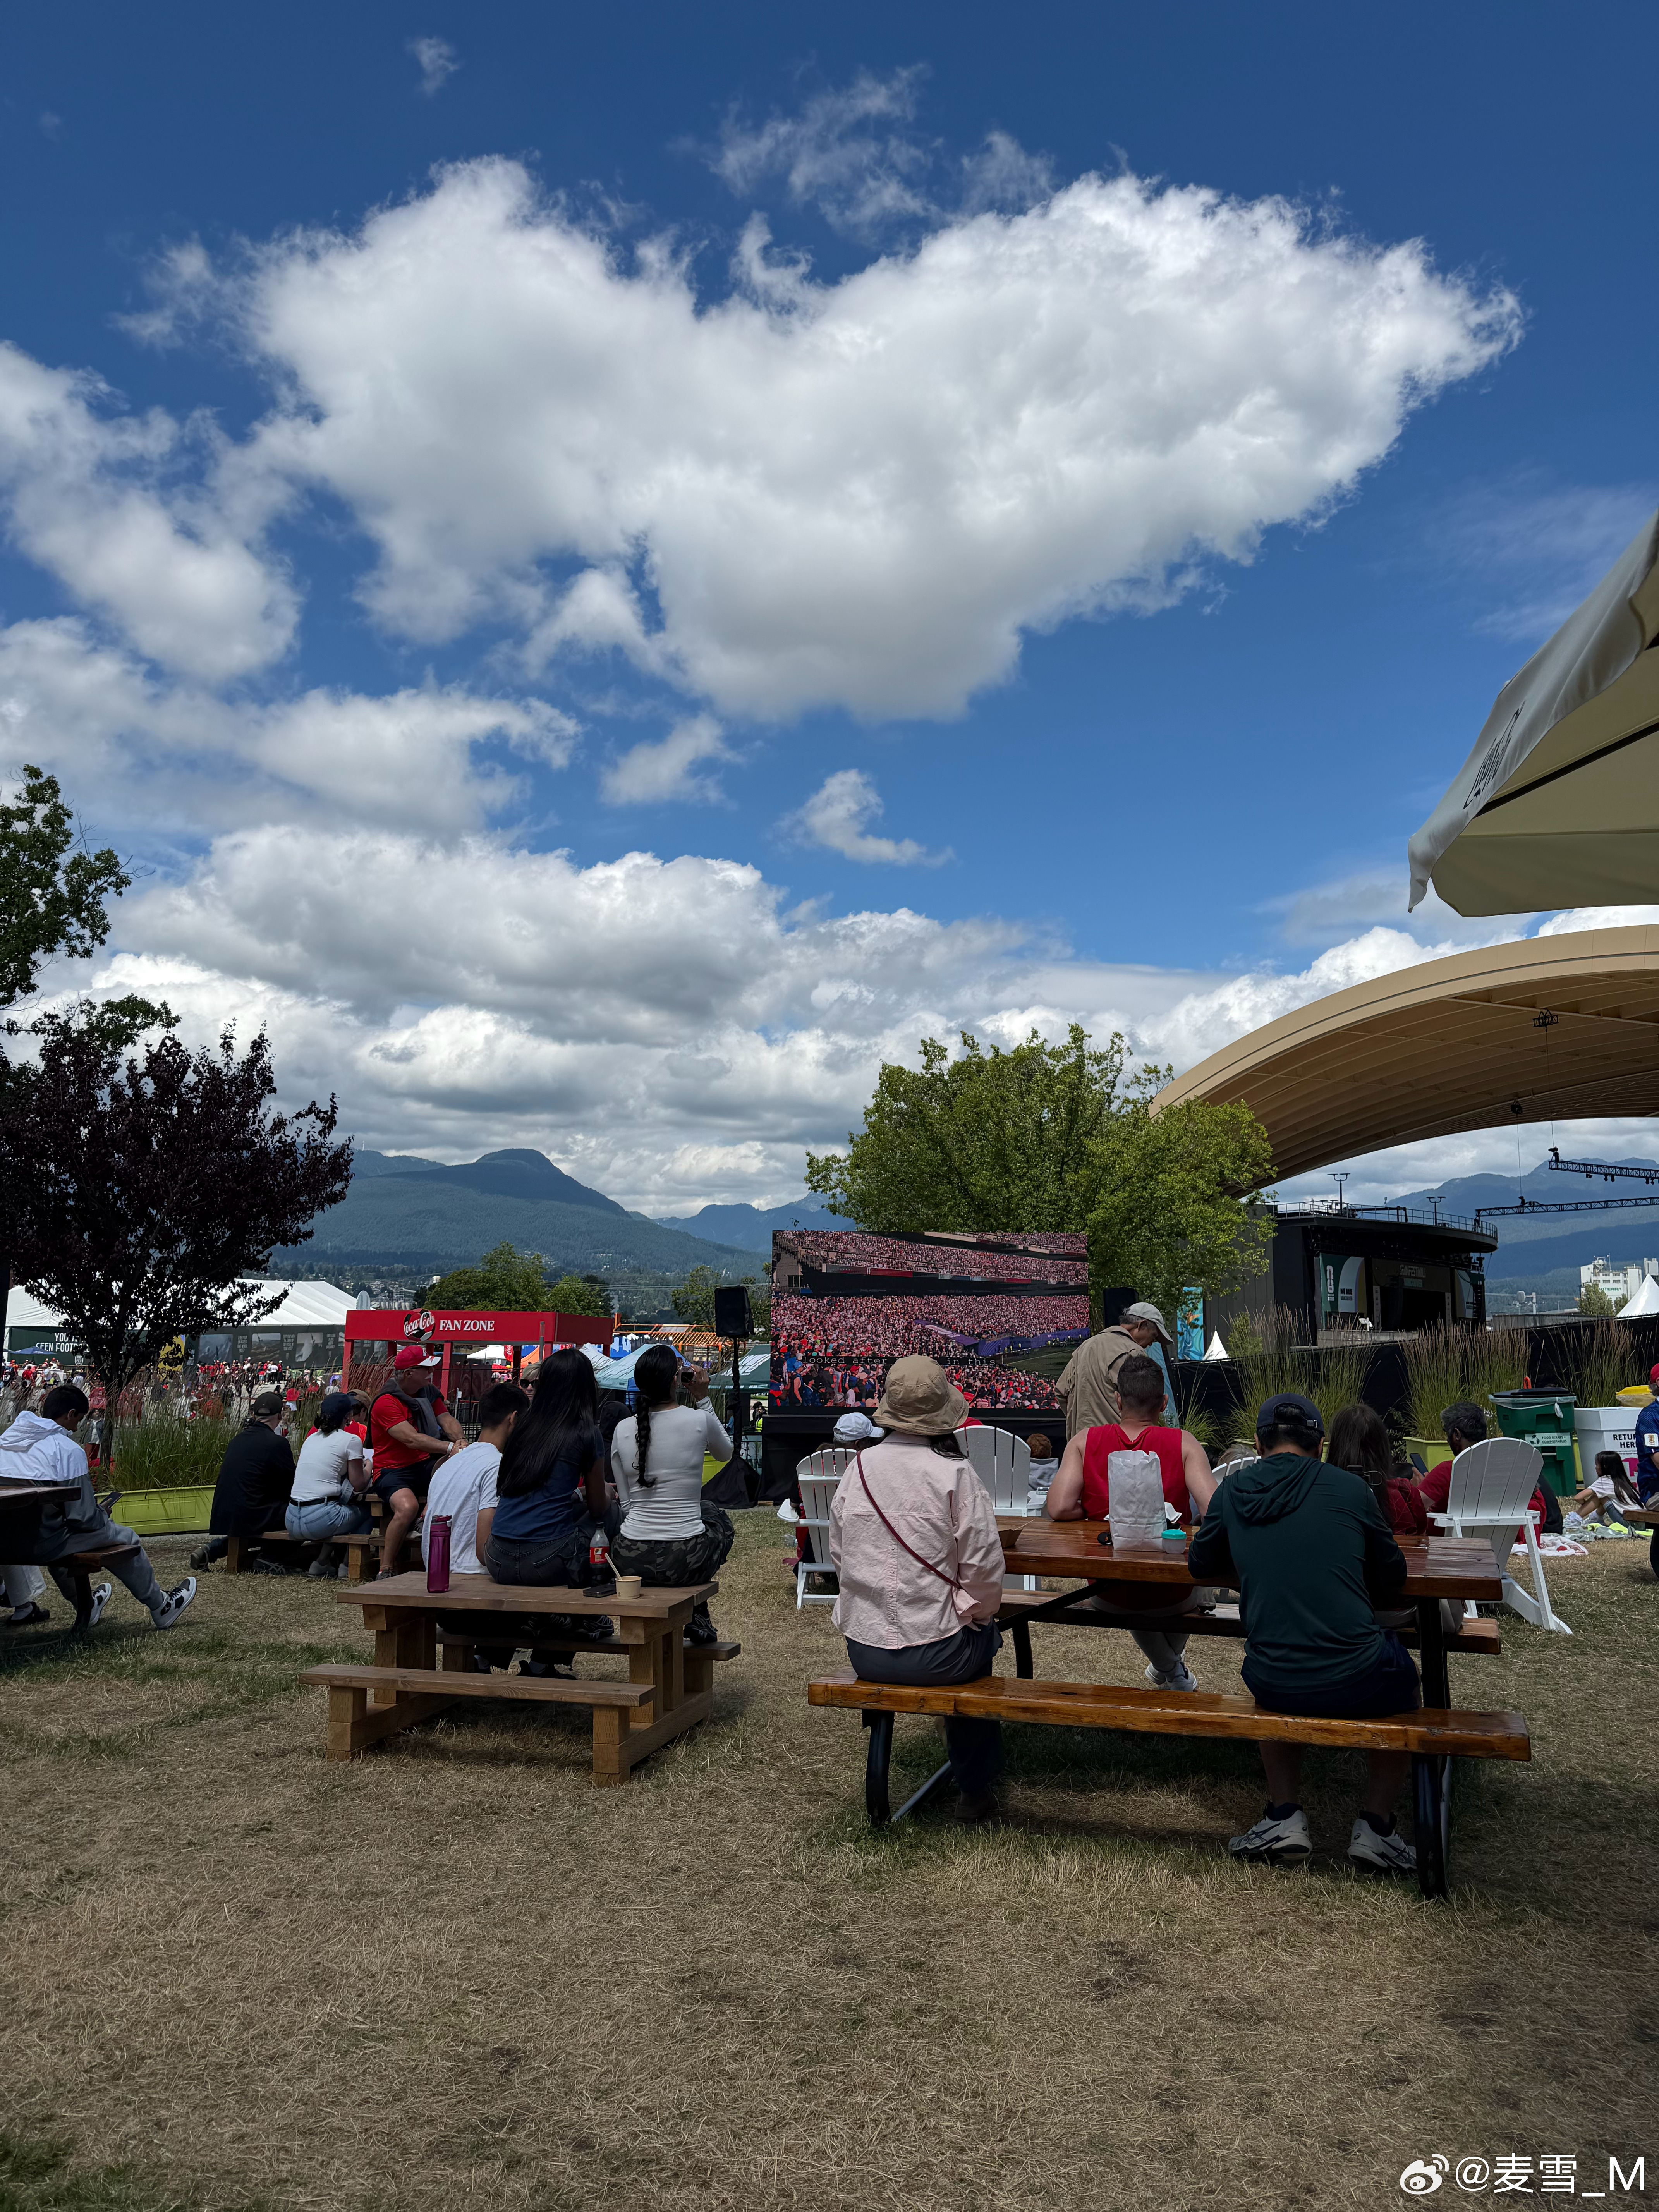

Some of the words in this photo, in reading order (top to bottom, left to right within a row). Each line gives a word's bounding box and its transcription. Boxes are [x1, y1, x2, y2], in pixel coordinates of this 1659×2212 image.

[404, 1311, 435, 1336] Coca-Cola
[439, 1320, 462, 1331] FAN
[463, 1320, 495, 1331] ZONE
